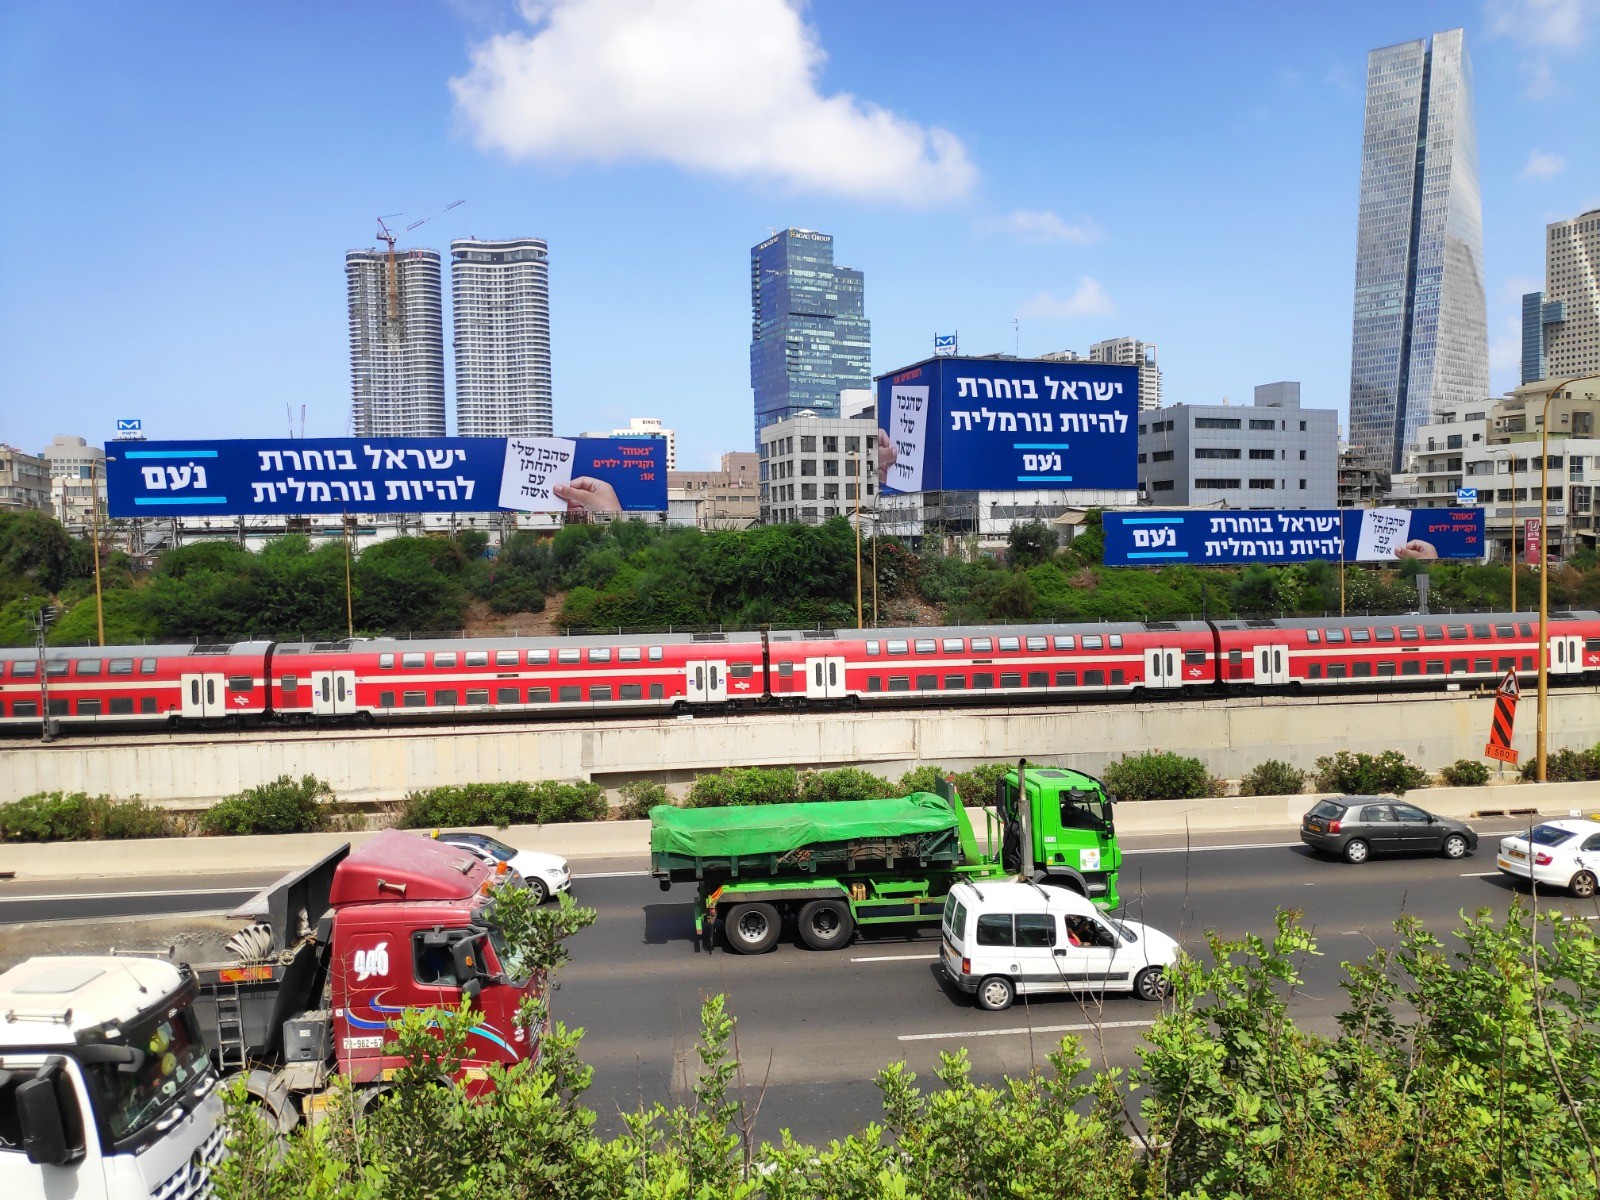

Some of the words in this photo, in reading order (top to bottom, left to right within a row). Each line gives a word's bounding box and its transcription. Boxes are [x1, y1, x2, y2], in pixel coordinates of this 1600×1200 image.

[956, 377, 1039, 399] בוחרת
[1044, 375, 1123, 401] ישראל
[896, 394, 923, 412] שהנכד
[900, 413, 915, 434] שלי
[950, 407, 1053, 433] נורמלית
[1060, 410, 1129, 434] להיות
[363, 444, 467, 470] ישראל
[511, 440, 535, 457] שלי
[538, 448, 570, 463] שהבן
[258, 449, 357, 471] בוחרת
[520, 459, 558, 473] יתחתן
[593, 458, 620, 468] ילדים
[623, 460, 655, 469] וקניית
[894, 461, 914, 479] יהודי
[384, 475, 476, 500] להיות
[528, 473, 546, 486] עם
[251, 477, 376, 502] נורמלית
[520, 485, 550, 499] אשה
[1210, 517, 1273, 533] בוחרת
[1277, 514, 1341, 533] ישראל
[1369, 511, 1384, 523] שלי
[1385, 516, 1406, 527] שהבן
[1374, 525, 1398, 535] יתחתן
[1429, 524, 1450, 532] ילדים
[1452, 524, 1477, 532] וקניית
[1204, 537, 1285, 556] נורמלית
[1290, 536, 1345, 555] להיות
[1378, 536, 1390, 545] עם
[1373, 545, 1392, 554] אשה
